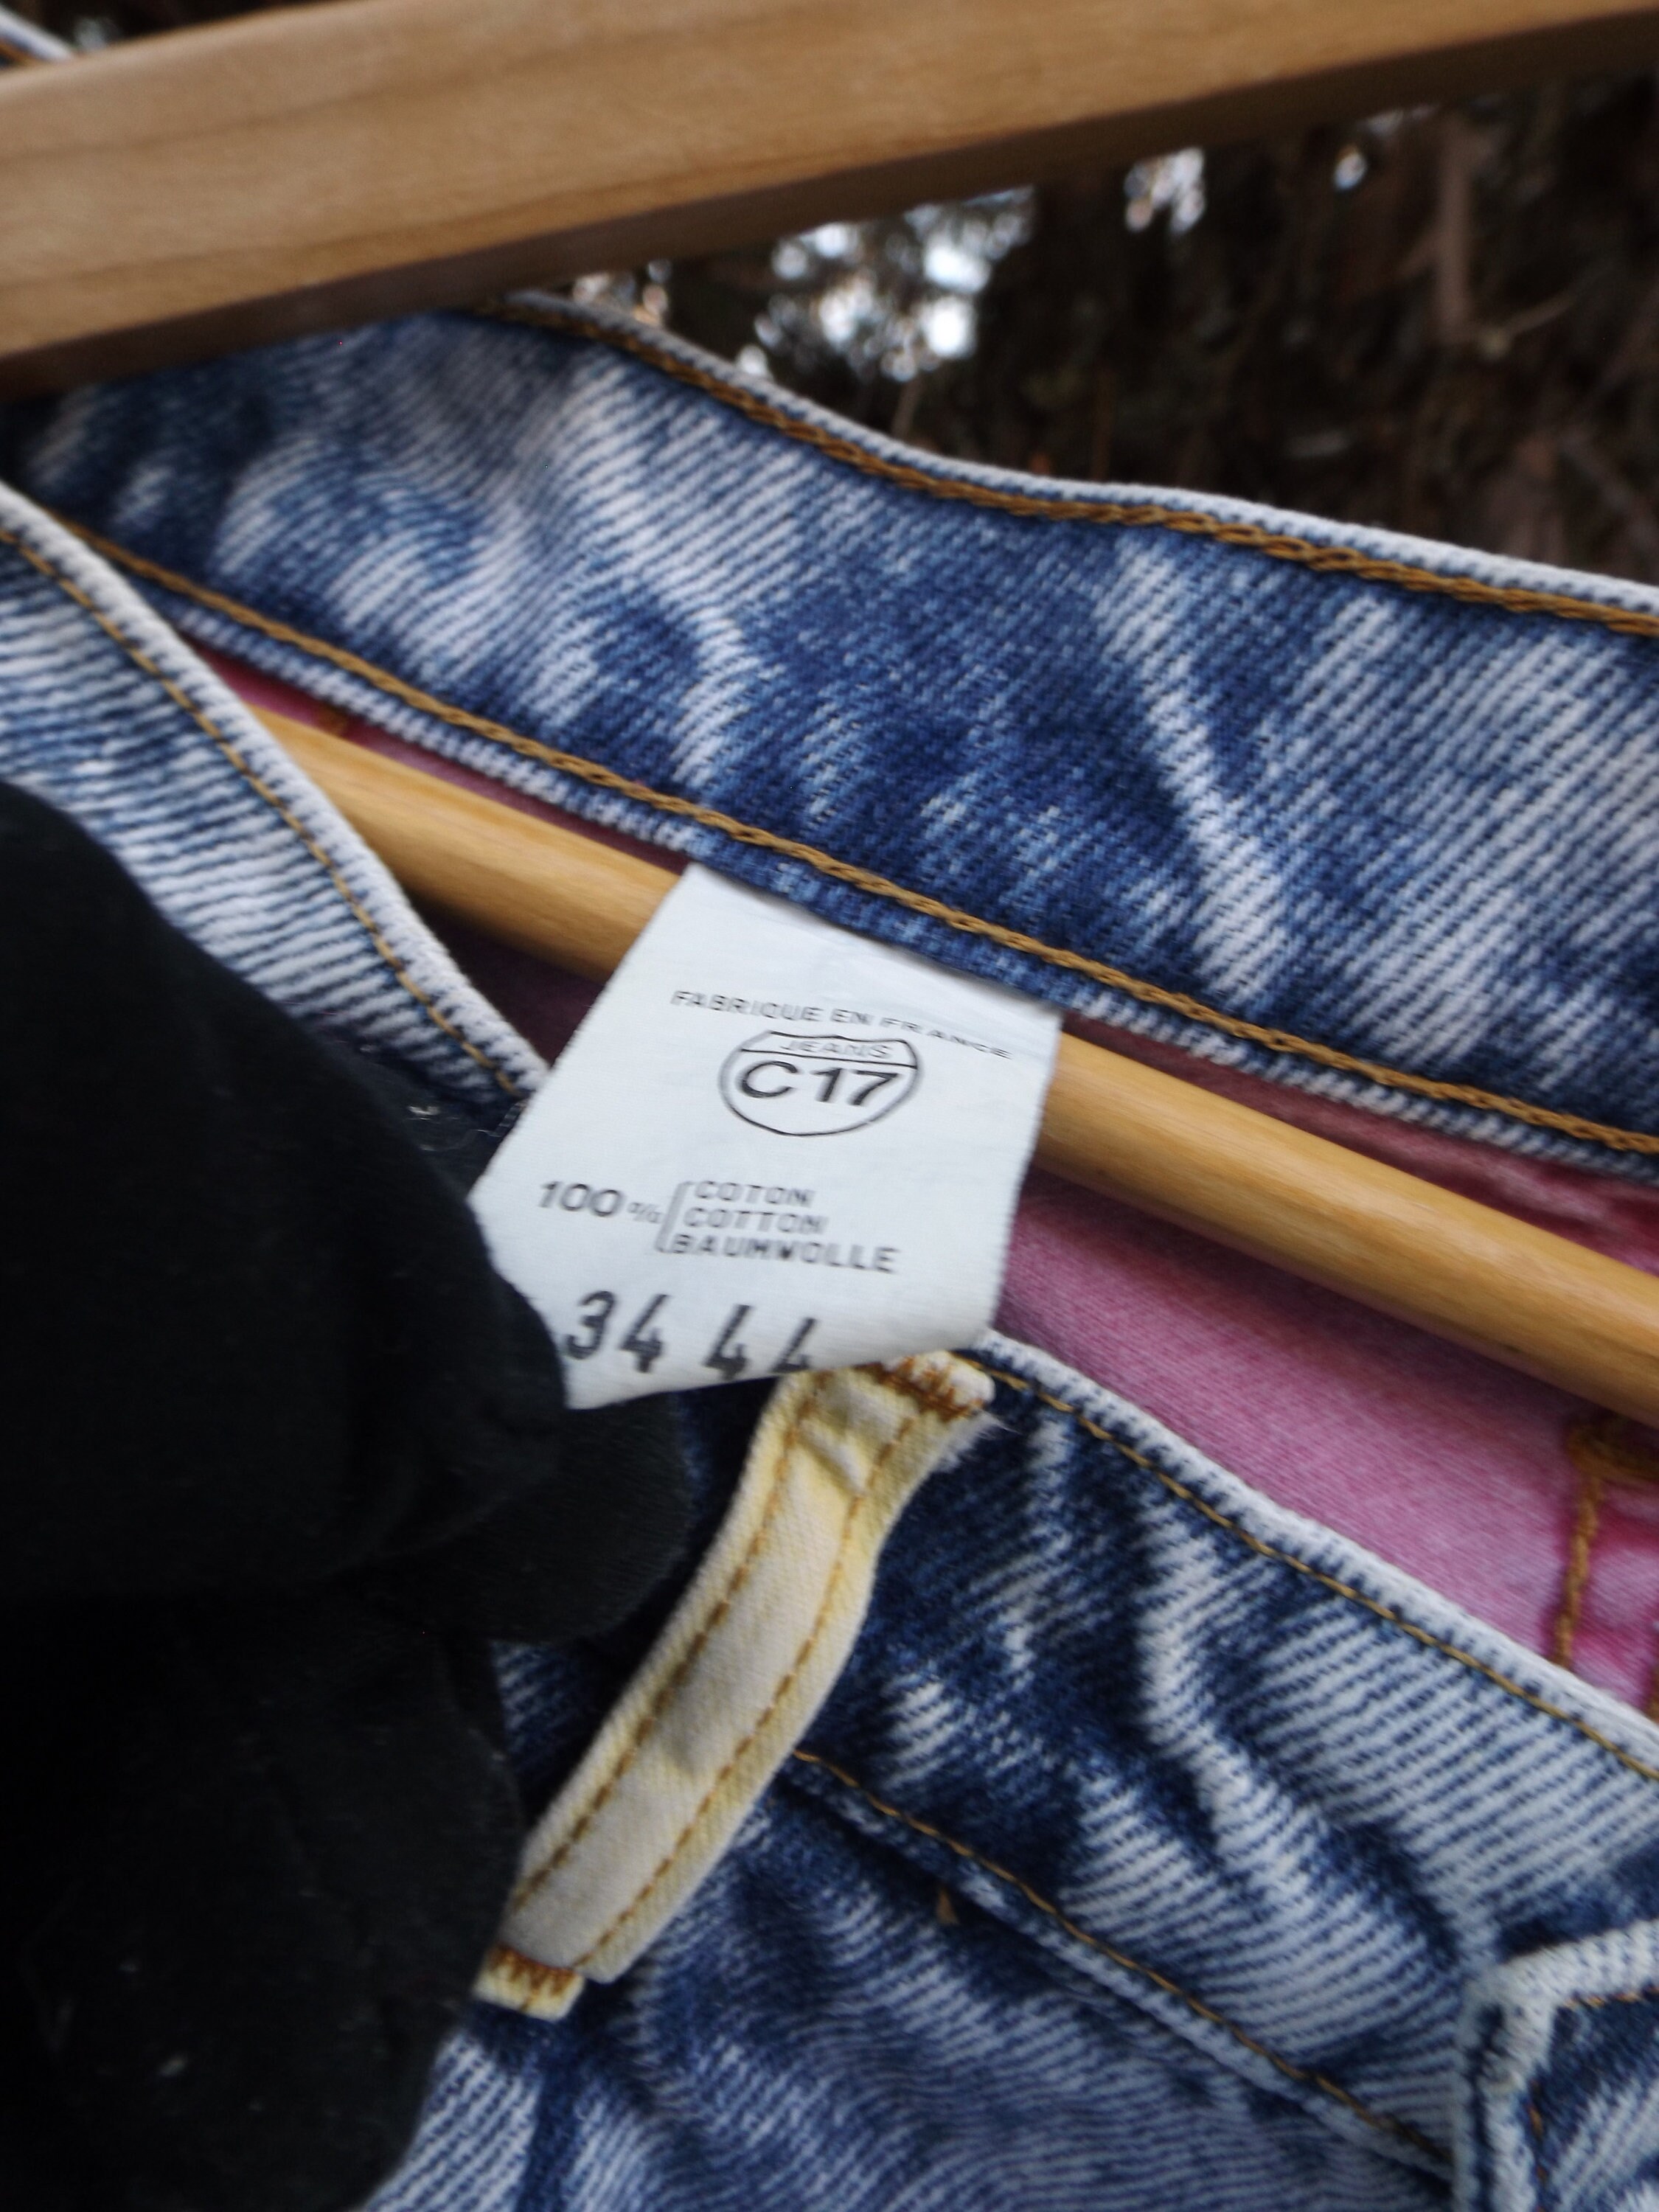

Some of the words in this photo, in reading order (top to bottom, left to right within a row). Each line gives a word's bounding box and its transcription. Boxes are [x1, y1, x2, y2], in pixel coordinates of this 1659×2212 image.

[669, 990, 825, 1023] FABRIQUE
[830, 1009, 873, 1027] EN
[880, 1018, 1013, 1060] FRANCE
[779, 1040, 894, 1060] JEANS
[692, 1180, 814, 1207] COTON
[681, 1206, 828, 1235] COTTON
[669, 1234, 900, 1273] BAUMWOLLE
[565, 1290, 671, 1373] 34
